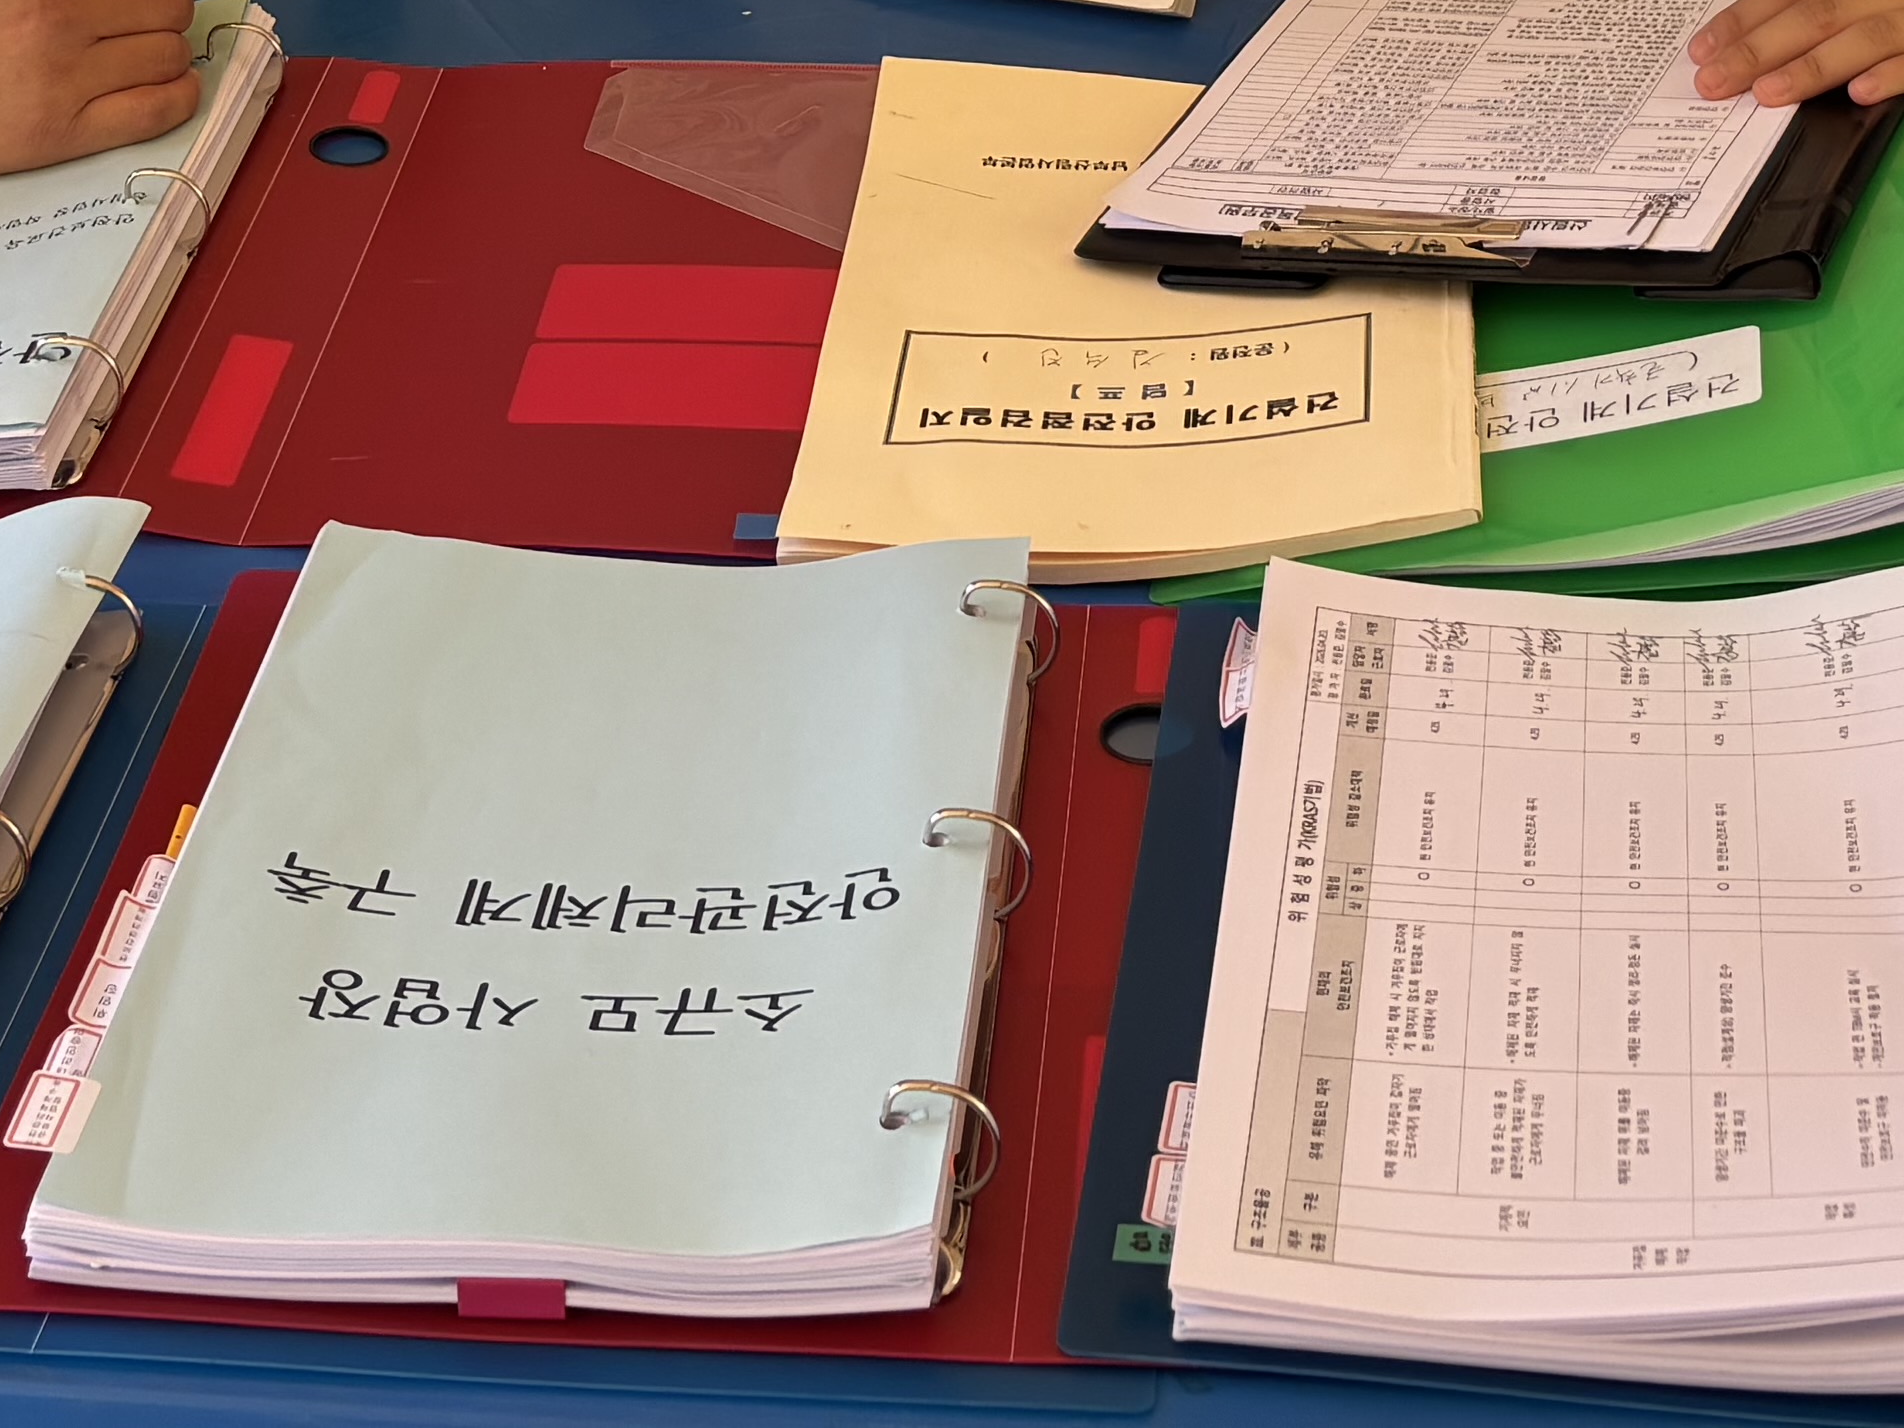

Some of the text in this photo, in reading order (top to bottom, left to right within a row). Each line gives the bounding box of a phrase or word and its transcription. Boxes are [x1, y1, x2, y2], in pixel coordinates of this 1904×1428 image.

[917, 390, 1340, 433] 건설기계 안전점검일지
[1486, 373, 1741, 439] 건설기계 안전
[266, 849, 901, 937] 안전관리체계 구축
[298, 968, 814, 1036] 소규모 사업장
